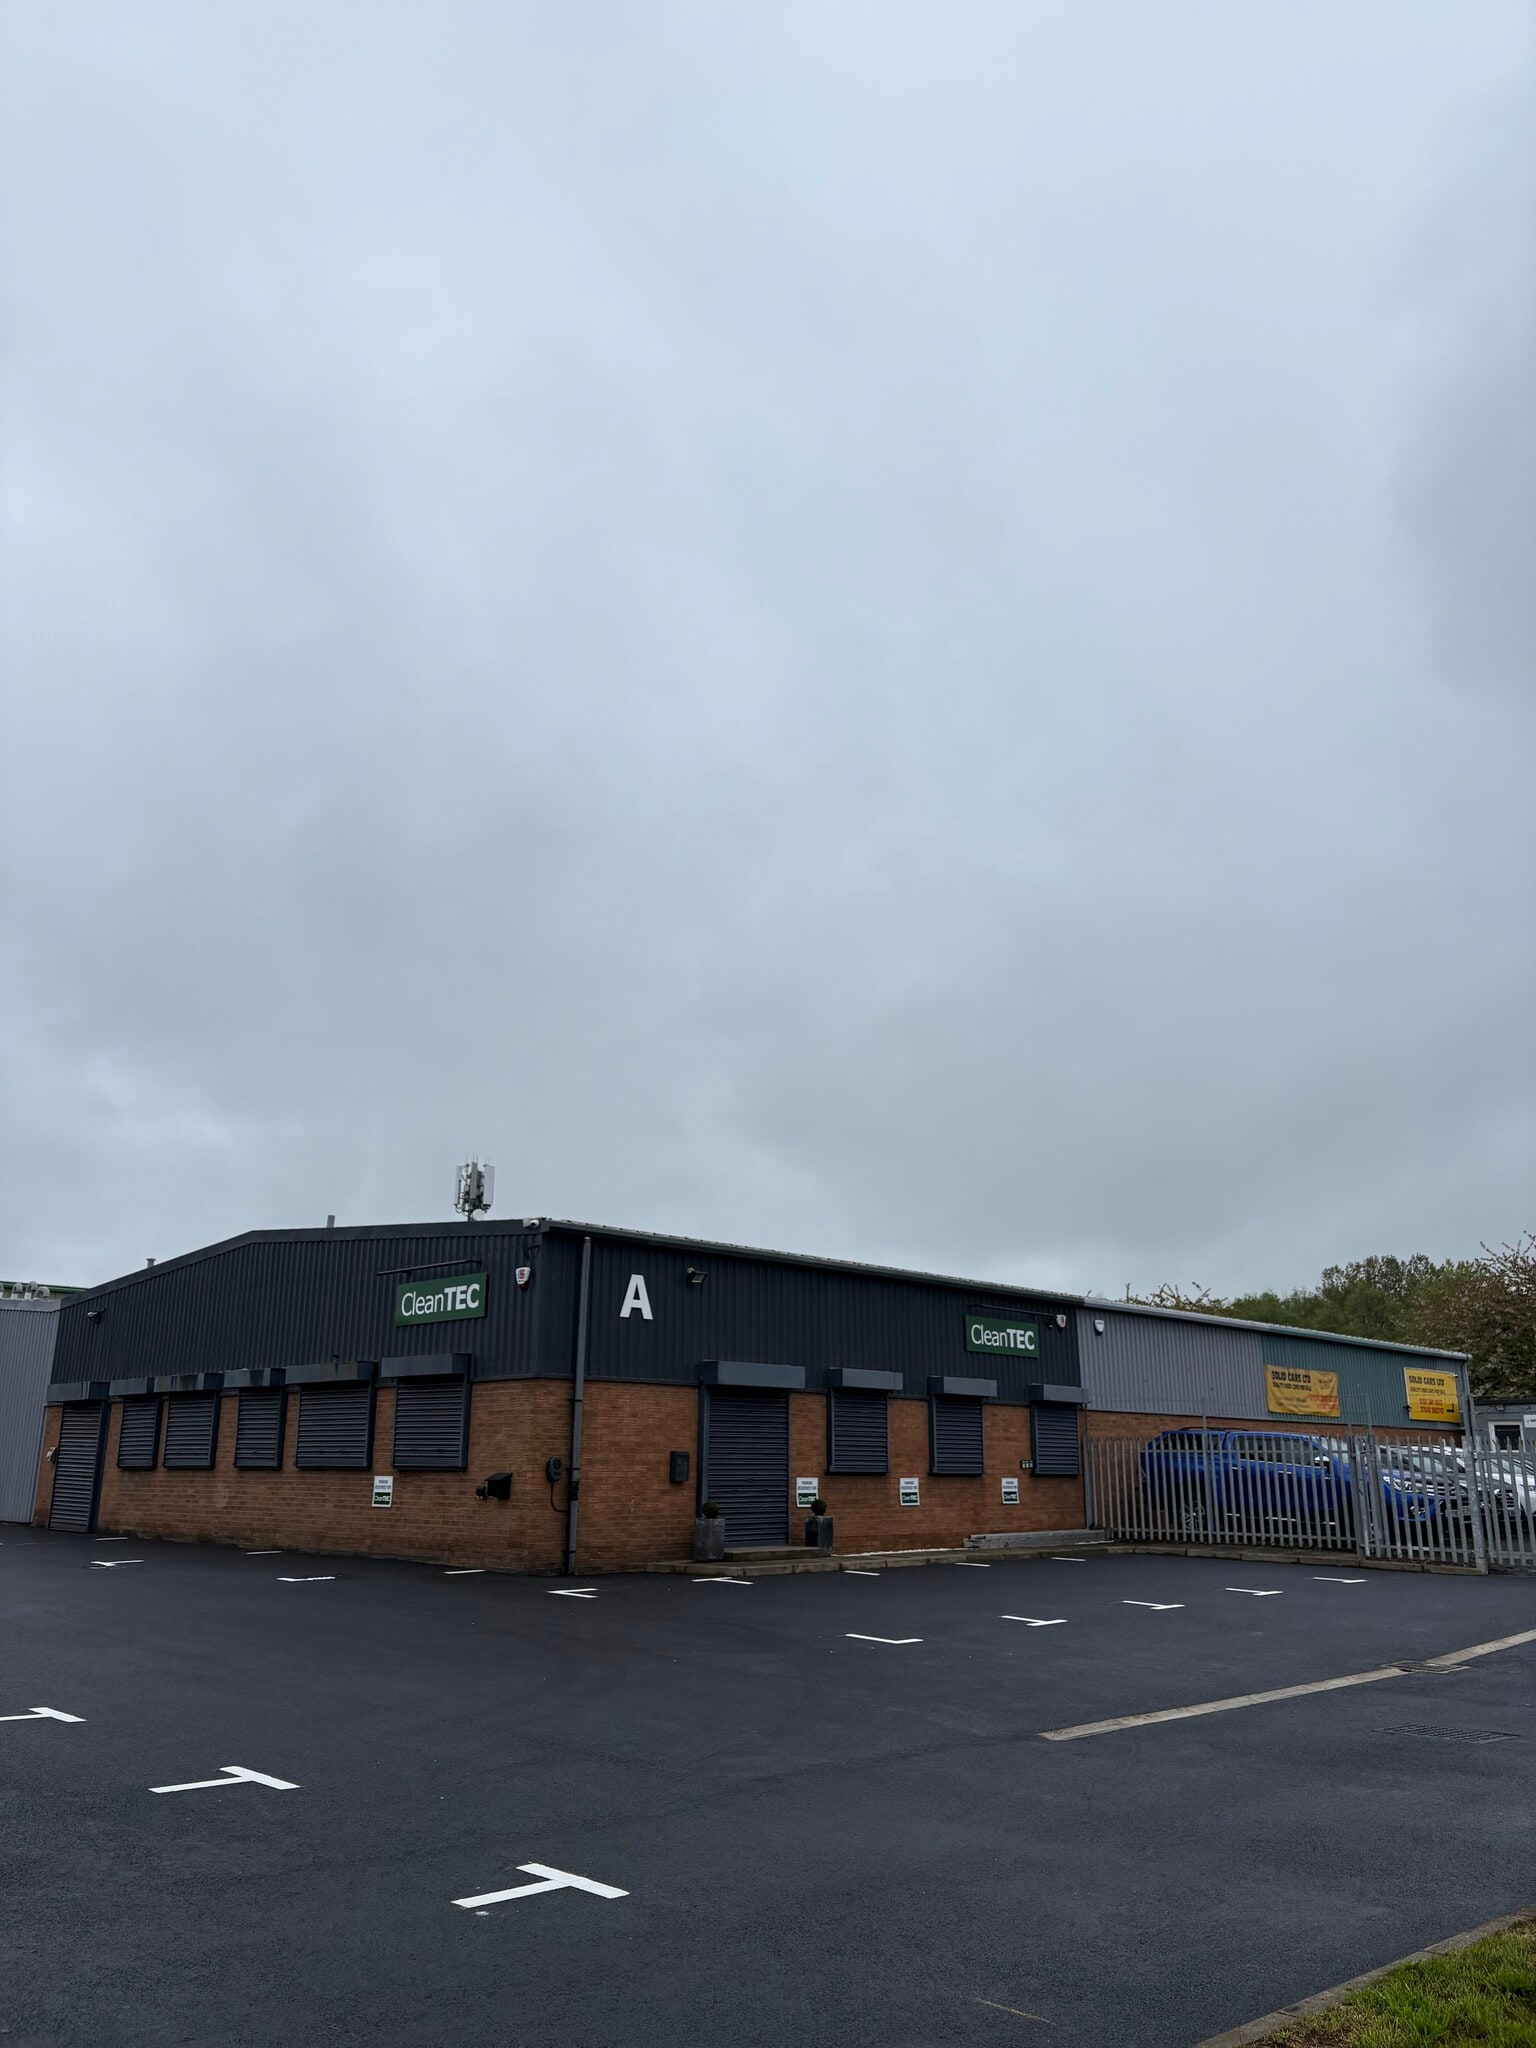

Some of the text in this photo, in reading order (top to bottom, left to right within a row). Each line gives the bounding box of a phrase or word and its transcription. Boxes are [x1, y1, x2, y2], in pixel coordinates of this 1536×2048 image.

[401, 1283, 480, 1316] CleanTEC
[619, 1273, 654, 1321] A
[970, 1323, 1035, 1351] CleanTEC
[1271, 1370, 1287, 1381] SOLID
[1287, 1372, 1302, 1383] CARS
[1302, 1374, 1311, 1384] LTD
[1408, 1375, 1445, 1387] SOLID CARS LTD
